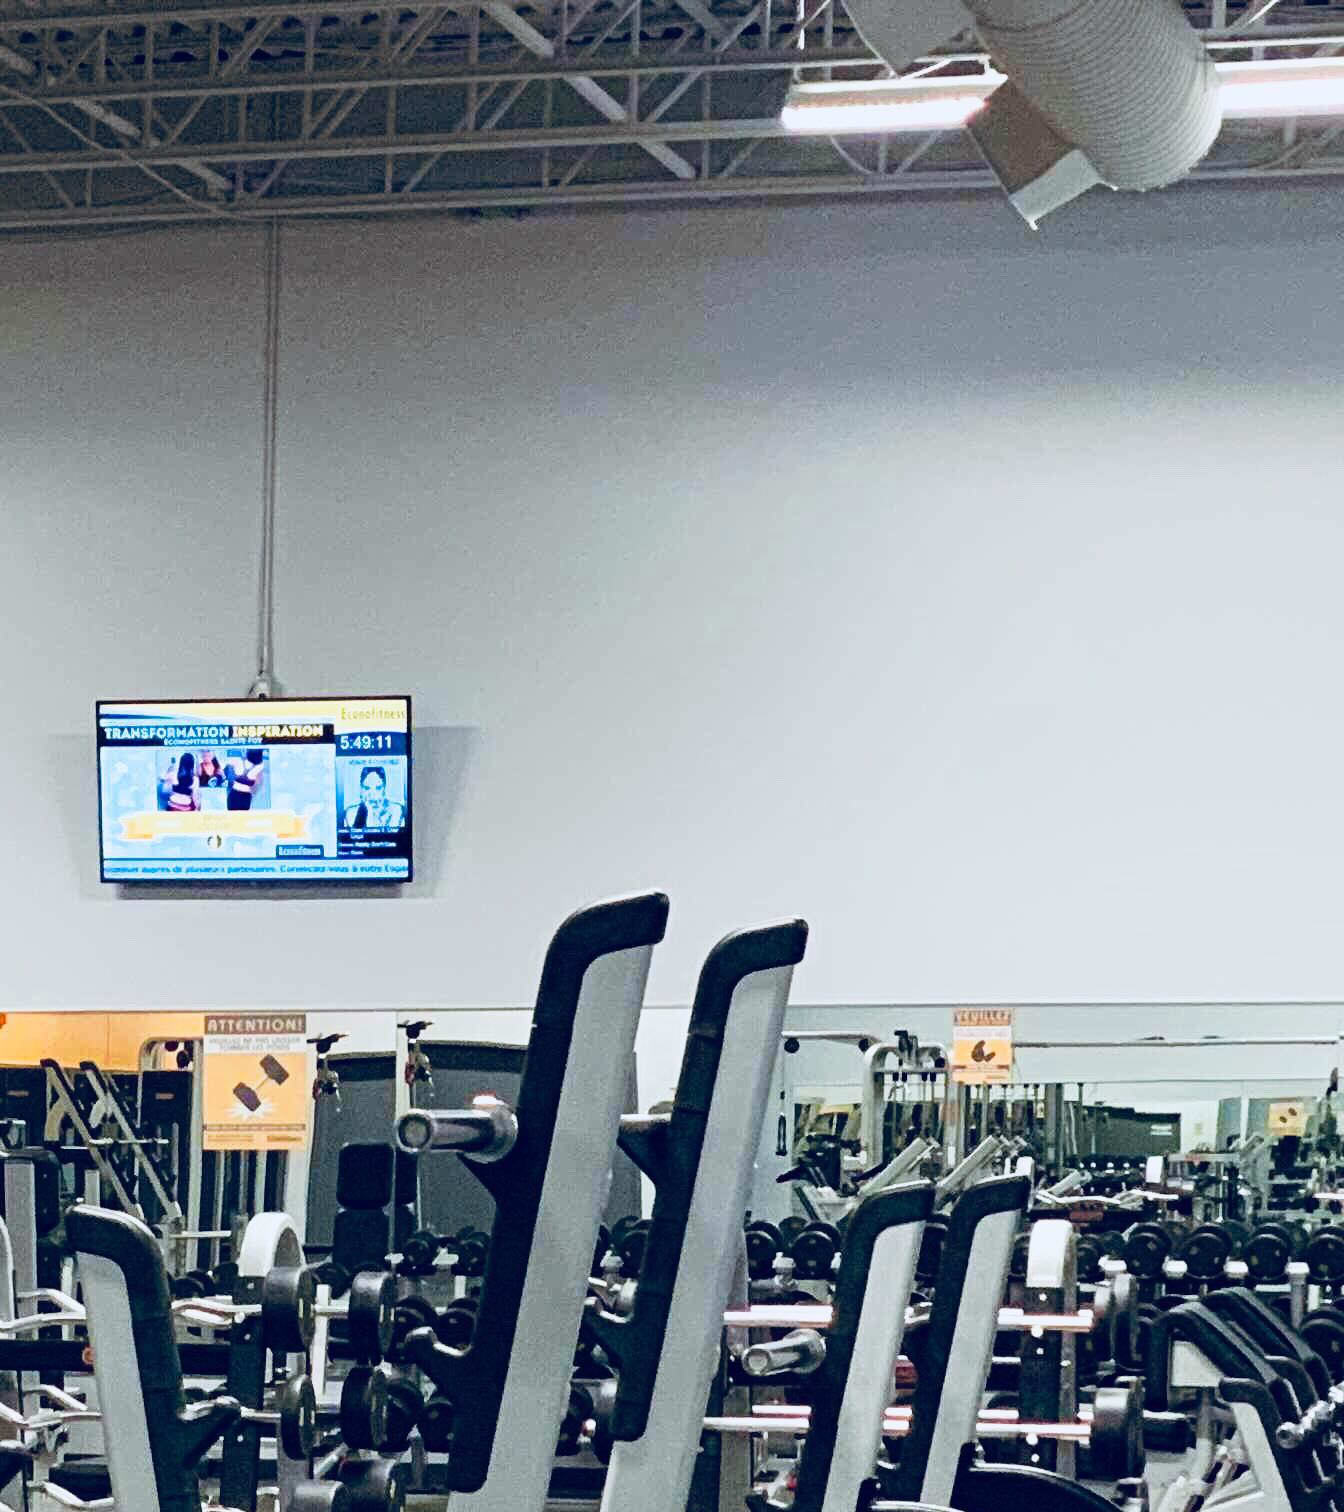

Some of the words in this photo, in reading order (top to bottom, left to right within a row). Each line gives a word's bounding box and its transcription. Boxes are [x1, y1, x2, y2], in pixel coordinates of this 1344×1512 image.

[104, 726, 230, 740] TRANSFORMATION
[232, 724, 324, 738] INSPIRATION
[340, 734, 393, 750] 5:49:11
[207, 1018, 303, 1032] ATTENTION!
